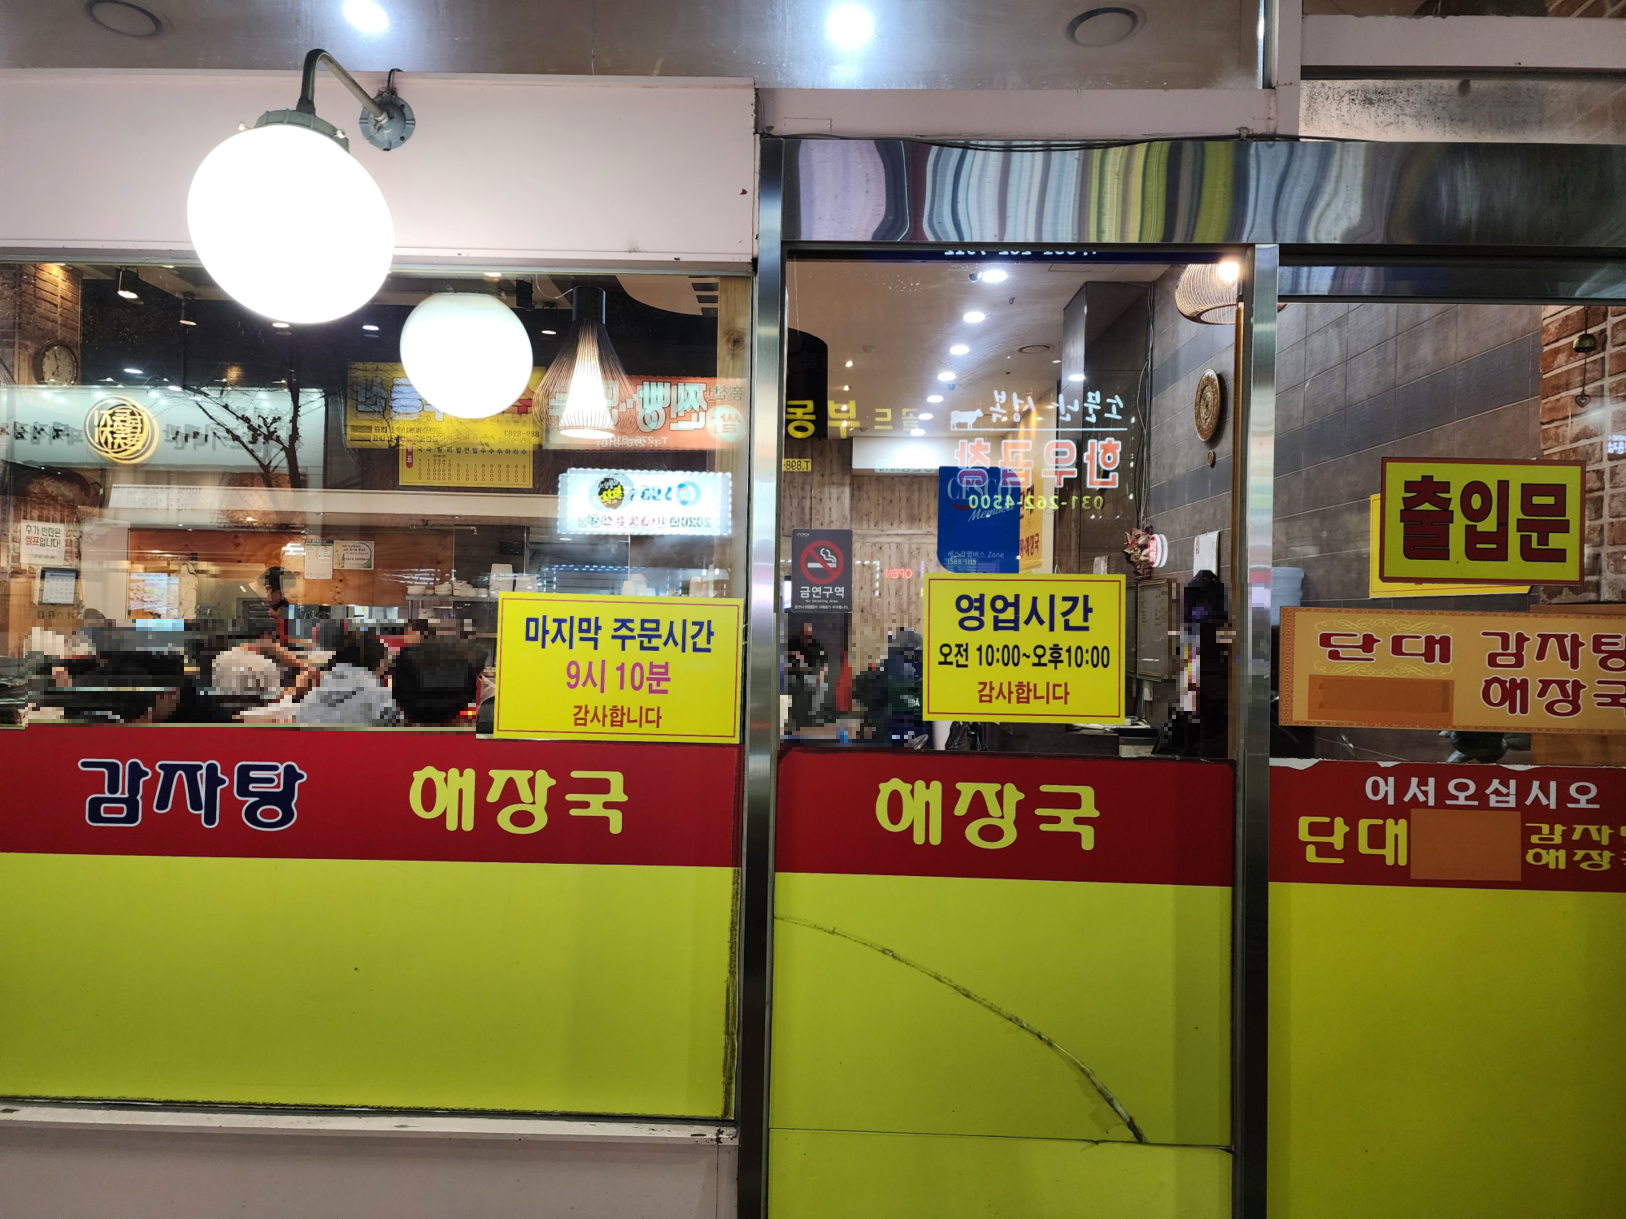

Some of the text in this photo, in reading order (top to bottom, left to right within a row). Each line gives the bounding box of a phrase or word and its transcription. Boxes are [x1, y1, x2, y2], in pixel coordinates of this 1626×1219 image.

[947, 477, 1012, 501] CESCO
[1399, 475, 1571, 564] 출입문
[799, 585, 845, 598] 금연구역
[954, 593, 1094, 633] 영업시간
[524, 614, 715, 654] 마지막 주문시간
[1317, 631, 1452, 665] 단대
[937, 642, 969, 669] 오전
[565, 659, 672, 695] 9시 10분
[976, 680, 1071, 706] 감사합니다
[572, 704, 663, 729] 감사합니다
[77, 758, 629, 835] 감자탕 해장국
[1364, 775, 1601, 810] 어서오십시오
[875, 777, 1101, 851] 해장국
[1297, 815, 1626, 867] 단대 감자
[1525, 848, 1626, 872] 해장
